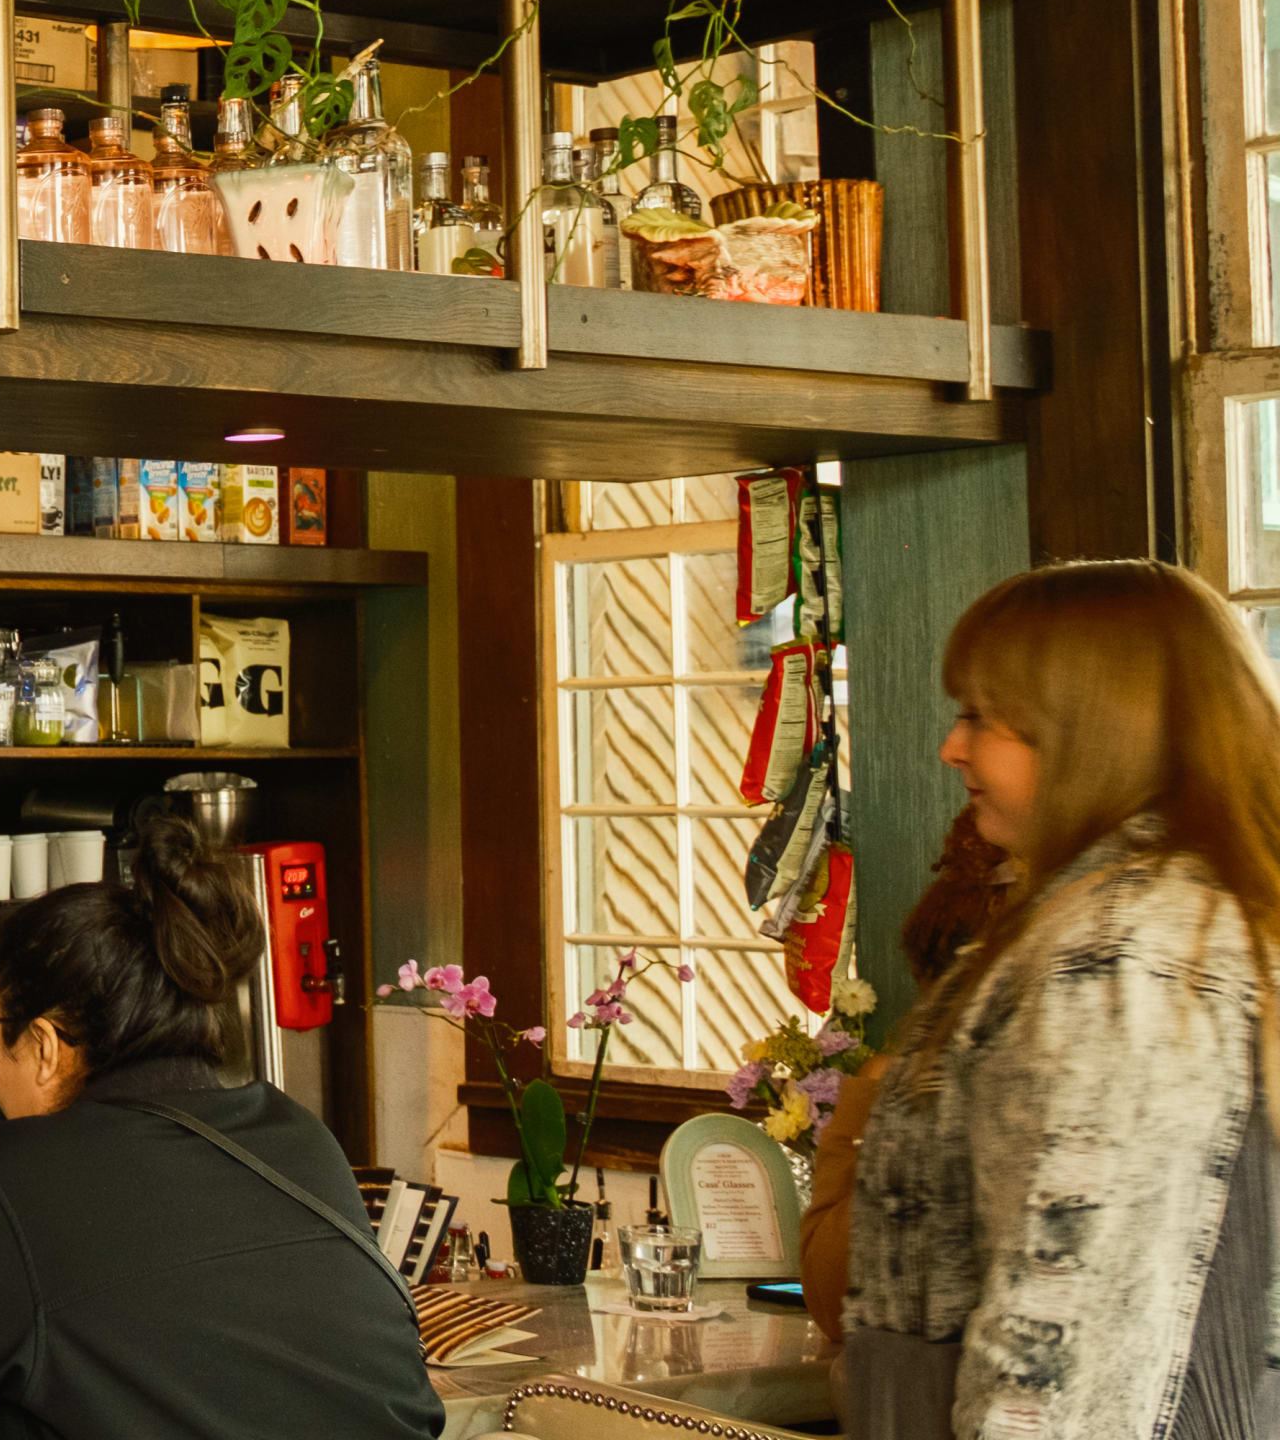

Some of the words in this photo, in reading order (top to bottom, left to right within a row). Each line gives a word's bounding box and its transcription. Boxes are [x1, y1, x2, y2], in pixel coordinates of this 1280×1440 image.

[16, 30, 40, 43] 431
[235, 664, 284, 717] G
[722, 1179, 756, 1190] Glasses
